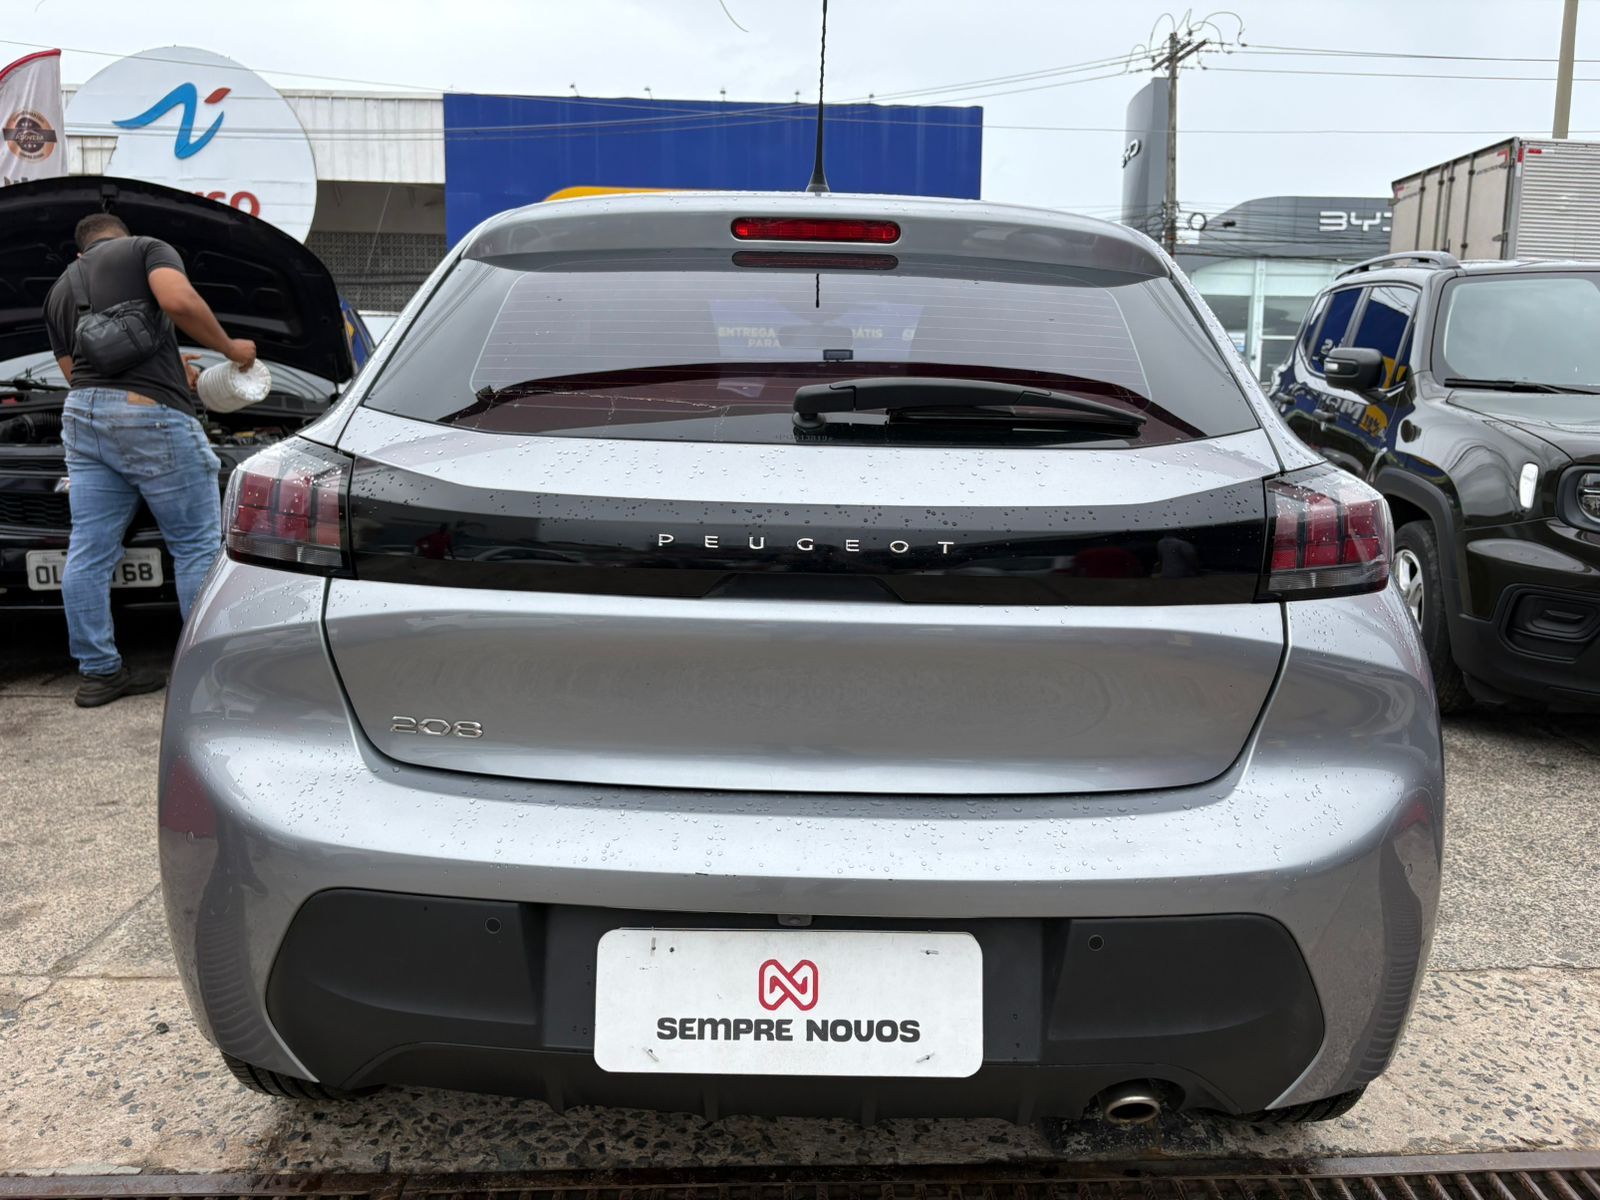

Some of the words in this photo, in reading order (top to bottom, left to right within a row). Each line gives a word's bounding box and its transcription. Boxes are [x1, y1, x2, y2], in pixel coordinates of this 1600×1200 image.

[748, 337, 781, 349] PARA
[658, 533, 954, 554] PEUGEOT
[390, 715, 483, 738] 208
[657, 1017, 793, 1042] SEMPRE
[806, 1018, 920, 1043] NOVOS
